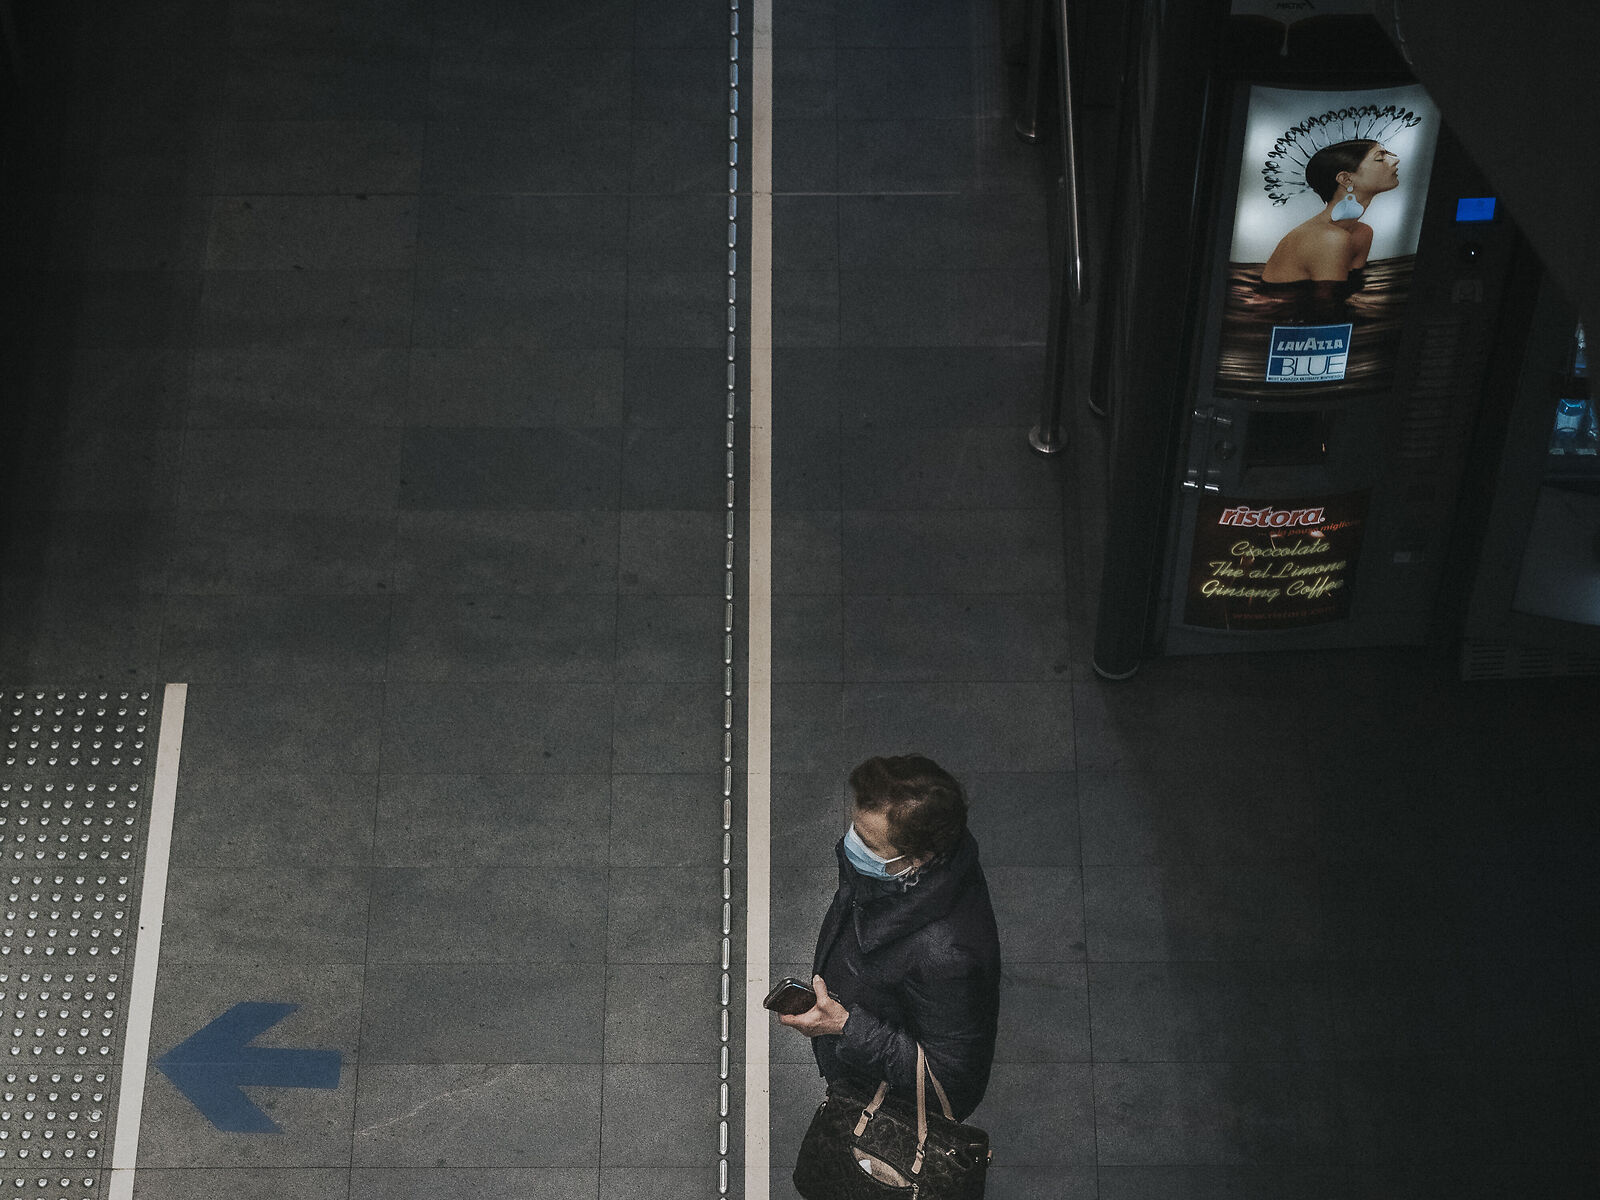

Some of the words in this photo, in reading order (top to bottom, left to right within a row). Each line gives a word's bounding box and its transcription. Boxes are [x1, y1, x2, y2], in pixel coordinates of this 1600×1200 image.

[1276, 337, 1344, 352] LAVAZZA
[1280, 354, 1346, 377] BLUE
[1230, 539, 1331, 558] Cioccolata
[1209, 560, 1245, 578] The
[1248, 562, 1273, 579] al
[1272, 560, 1347, 579] Limone
[1201, 579, 1281, 604] Ginseng
[1286, 576, 1345, 599] Coffee
